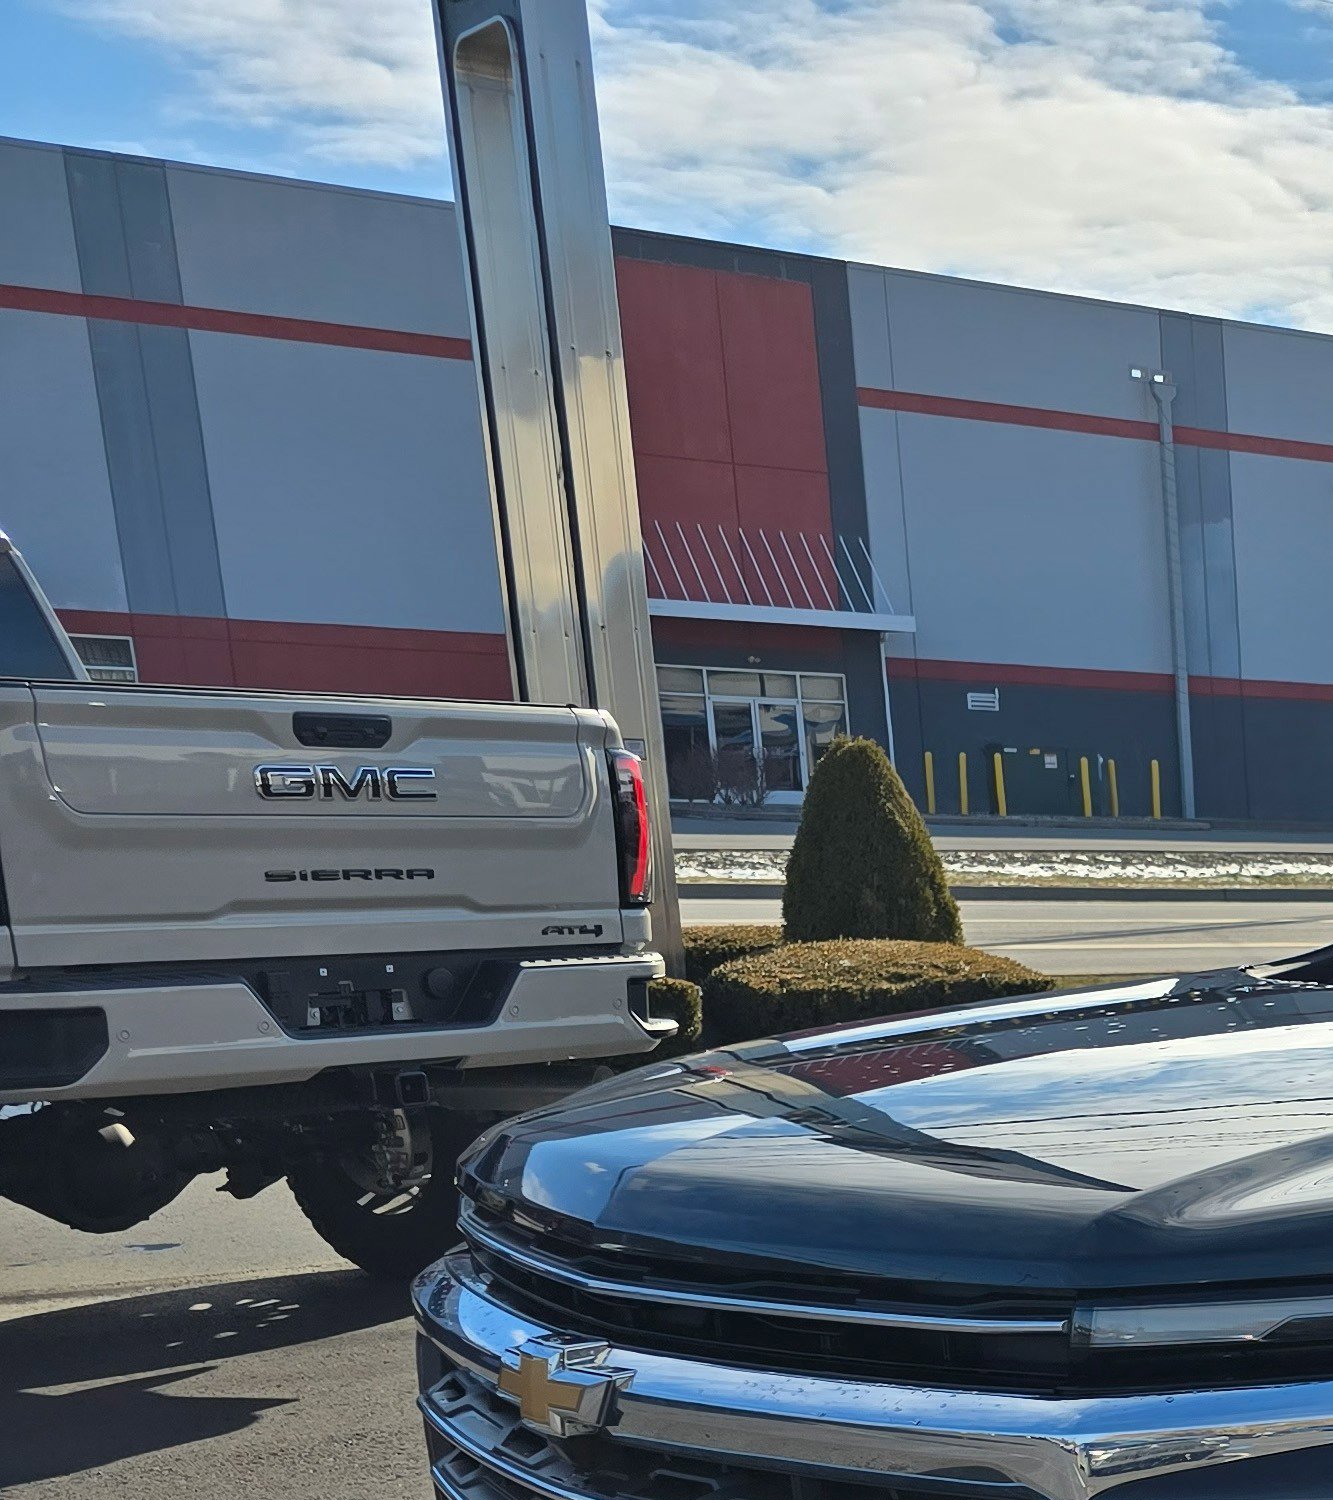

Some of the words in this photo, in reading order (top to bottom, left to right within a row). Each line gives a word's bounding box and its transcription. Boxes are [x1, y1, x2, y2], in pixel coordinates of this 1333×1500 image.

[254, 764, 438, 801] GMC
[264, 868, 435, 882] SIERRA
[541, 924, 603, 938] AT4
